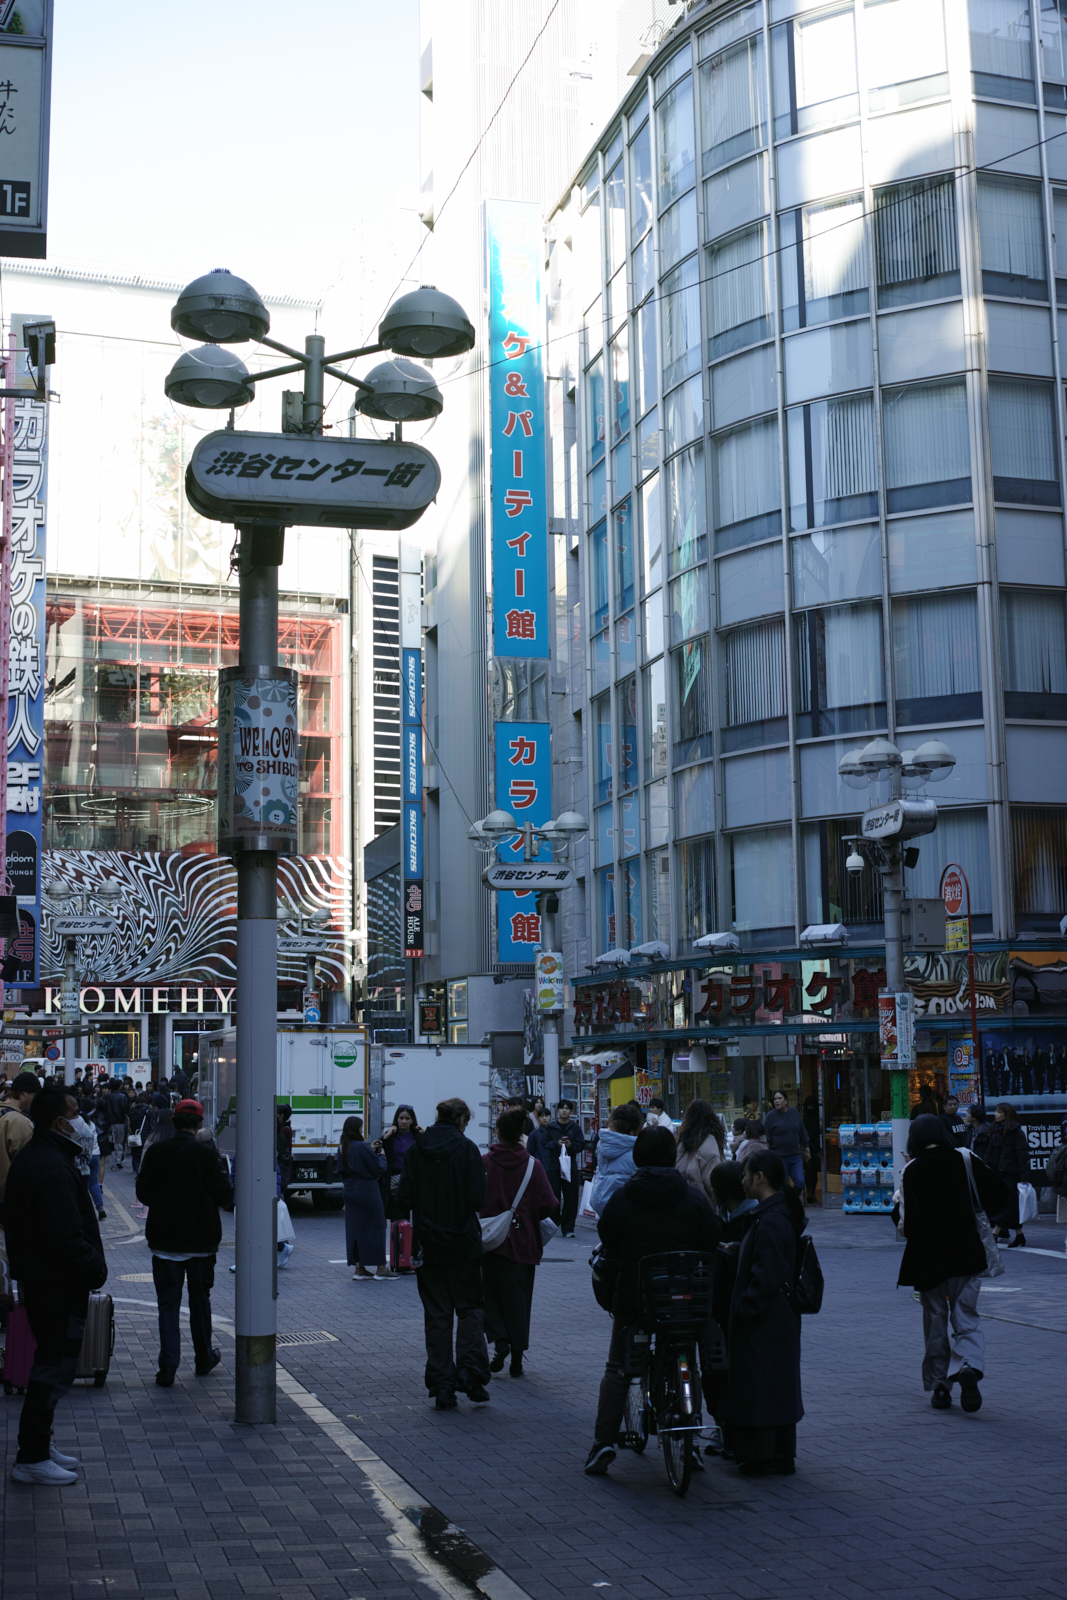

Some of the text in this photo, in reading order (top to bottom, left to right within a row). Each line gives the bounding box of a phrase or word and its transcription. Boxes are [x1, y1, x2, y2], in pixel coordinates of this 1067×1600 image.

[3, 184, 27, 214] 1F
[205, 450, 426, 488] 渋谷センター街
[8, 396, 46, 758] カラオケの鉄人
[408, 655, 416, 718] SKECHERS
[7, 762, 40, 785] 2F
[237, 761, 254, 773] TO
[409, 731, 417, 796] SKECHERS
[864, 808, 900, 832] 渋谷センター街
[509, 736, 541, 944] カラ館
[6, 853, 34, 867] ploom
[492, 870, 570, 881] 渋谷センター街
[944, 883, 962, 902] 消火栓
[56, 921, 113, 929] 渋谷センター街
[44, 986, 237, 1014] KOMEHY
[573, 987, 631, 1026] カラオケ館
[701, 968, 888, 1017] カラオケ館
